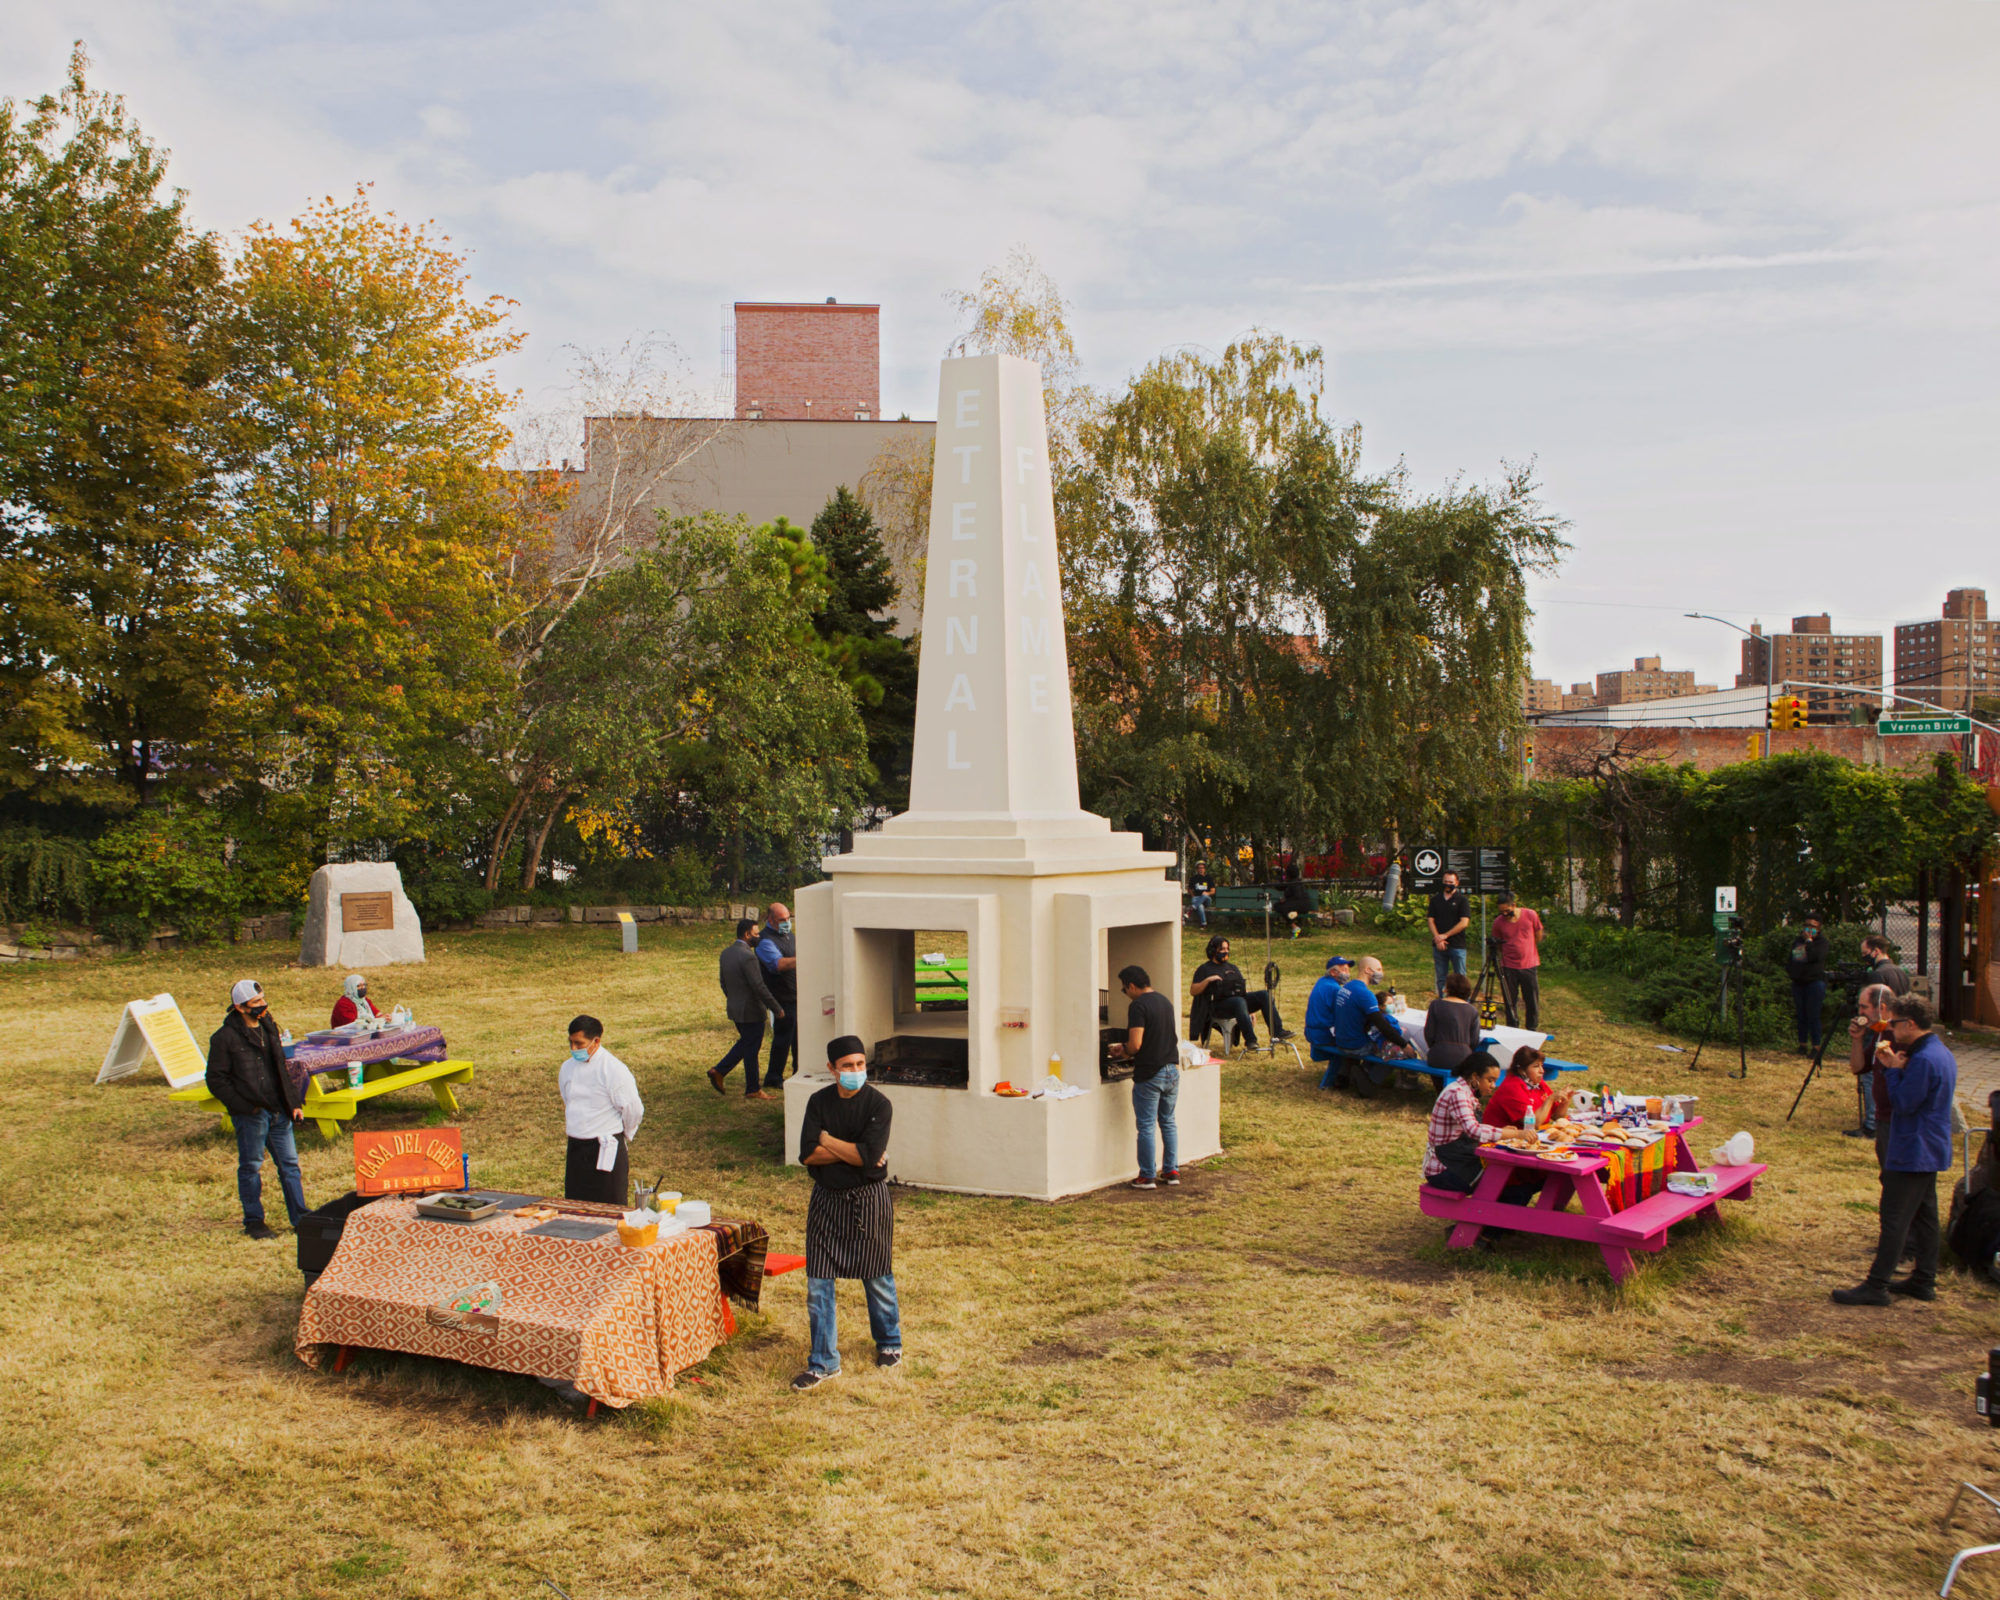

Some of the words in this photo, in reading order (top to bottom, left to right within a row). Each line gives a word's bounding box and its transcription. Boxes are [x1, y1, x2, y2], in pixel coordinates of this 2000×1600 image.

[944, 389, 982, 770] ETERNAL
[1016, 446, 1051, 715] FLAME
[1890, 723, 1931, 731] Vernon
[1934, 722, 1960, 730] Blvd
[357, 1143, 395, 1179] CASA
[393, 1133, 422, 1155] DEL
[426, 1139, 460, 1172] CHEF
[383, 1175, 441, 1190] BISTRO
